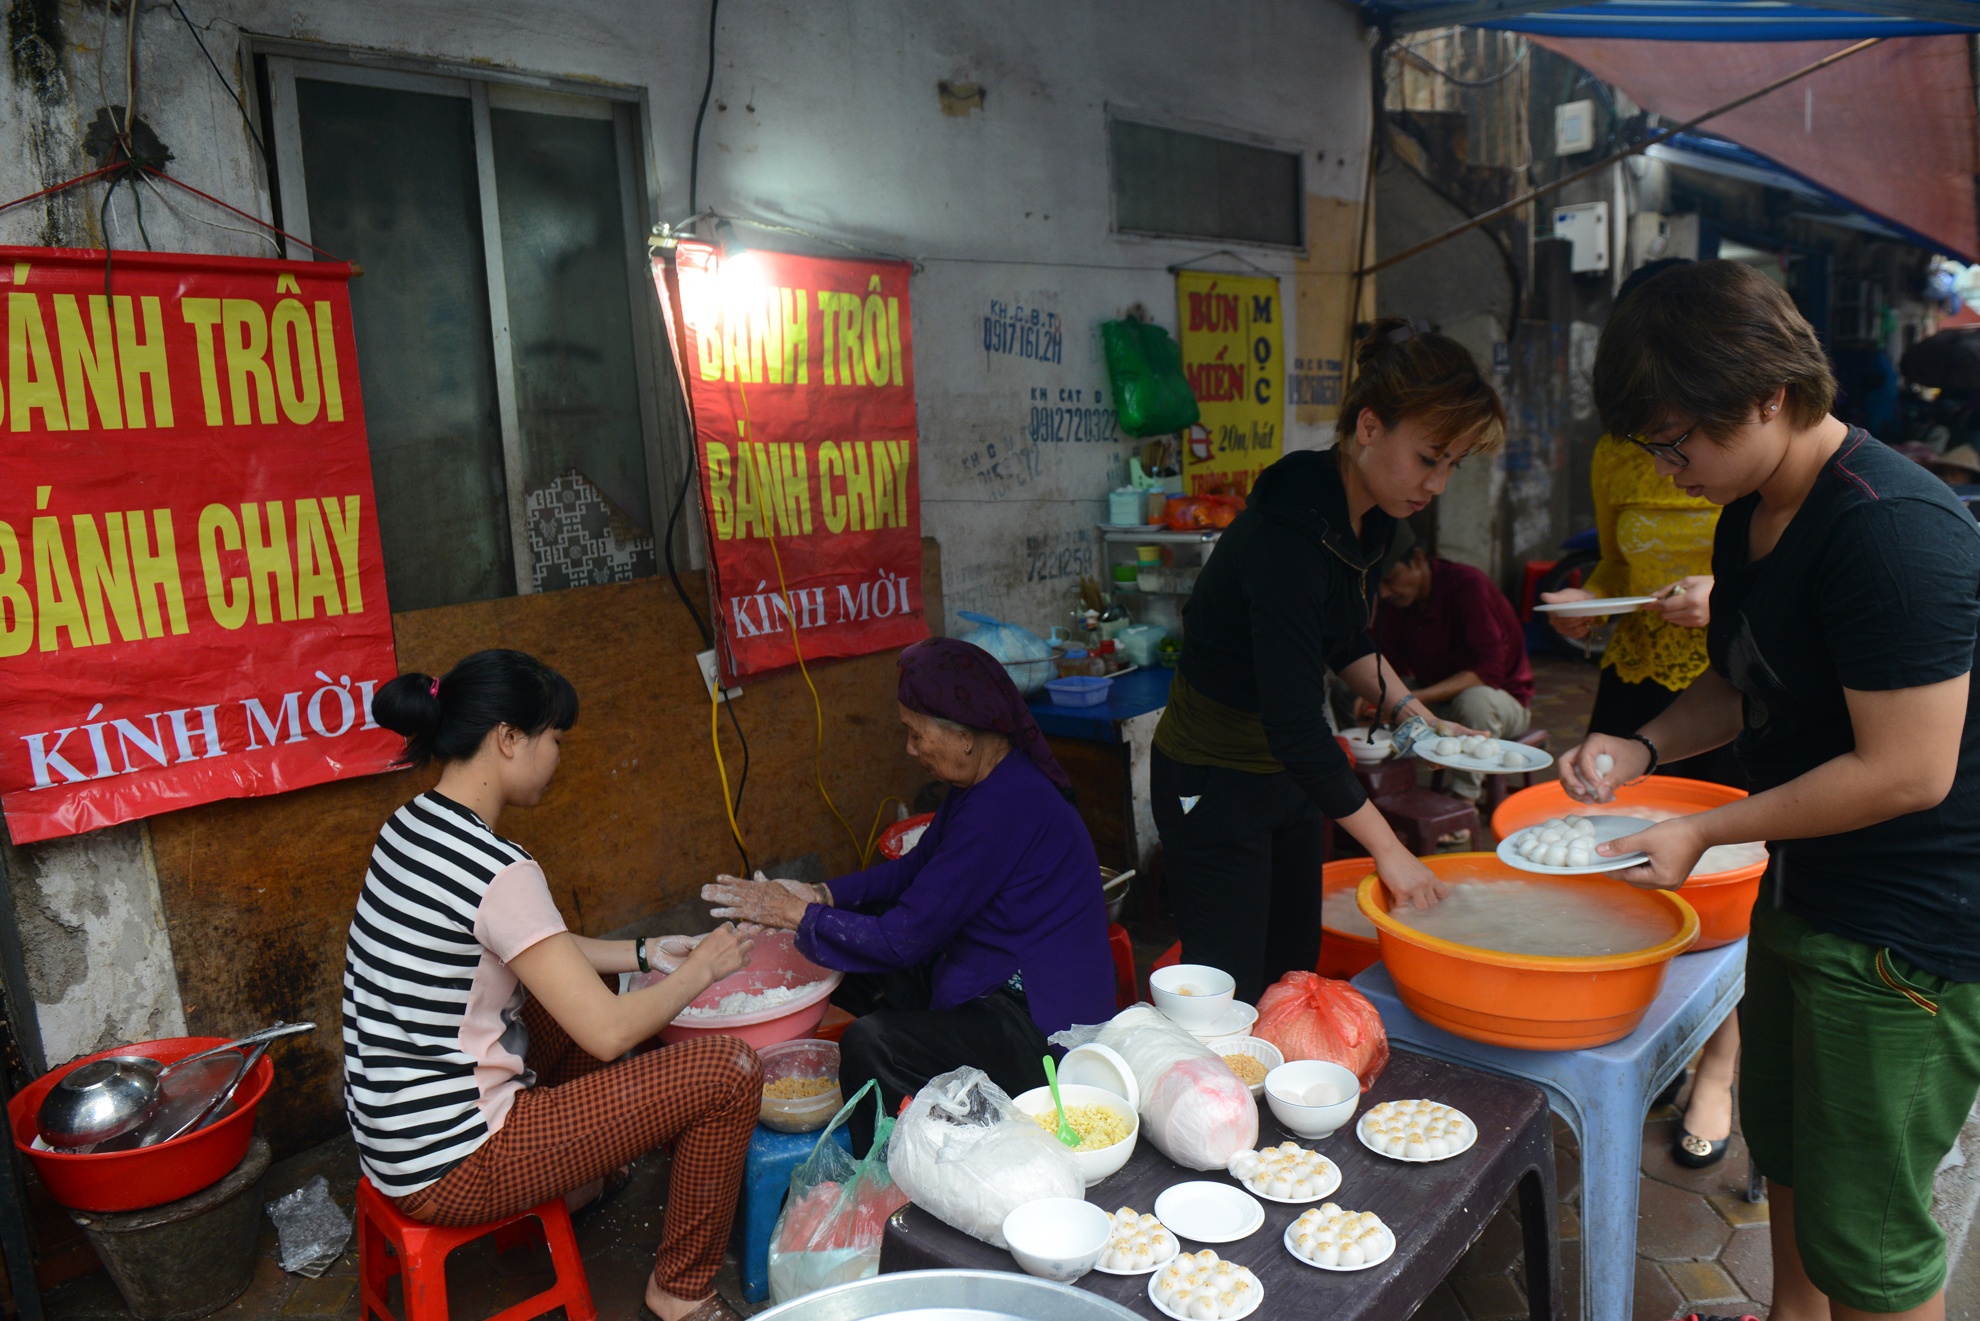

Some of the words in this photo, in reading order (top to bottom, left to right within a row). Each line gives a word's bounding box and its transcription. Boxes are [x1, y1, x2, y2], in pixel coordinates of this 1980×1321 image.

[0, 263, 175, 432] ÁNH
[181, 273, 345, 427] TRÔI
[818, 275, 904, 387] TRÔI
[1188, 281, 1240, 333] BÚN
[1030, 406, 1119, 443] 0912720322
[1031, 387, 1048, 402] KH
[1059, 388, 1082, 402] CAT
[705, 419, 813, 541] BÁNH
[818, 440, 911, 534] CHAY
[0, 486, 191, 658] BÁNH
[198, 495, 365, 631] CHAY
[729, 579, 829, 638] KÍNH
[836, 567, 911, 624] MỜI
[20, 702, 228, 792] KÍNH
[238, 670, 381, 752] MỜI
